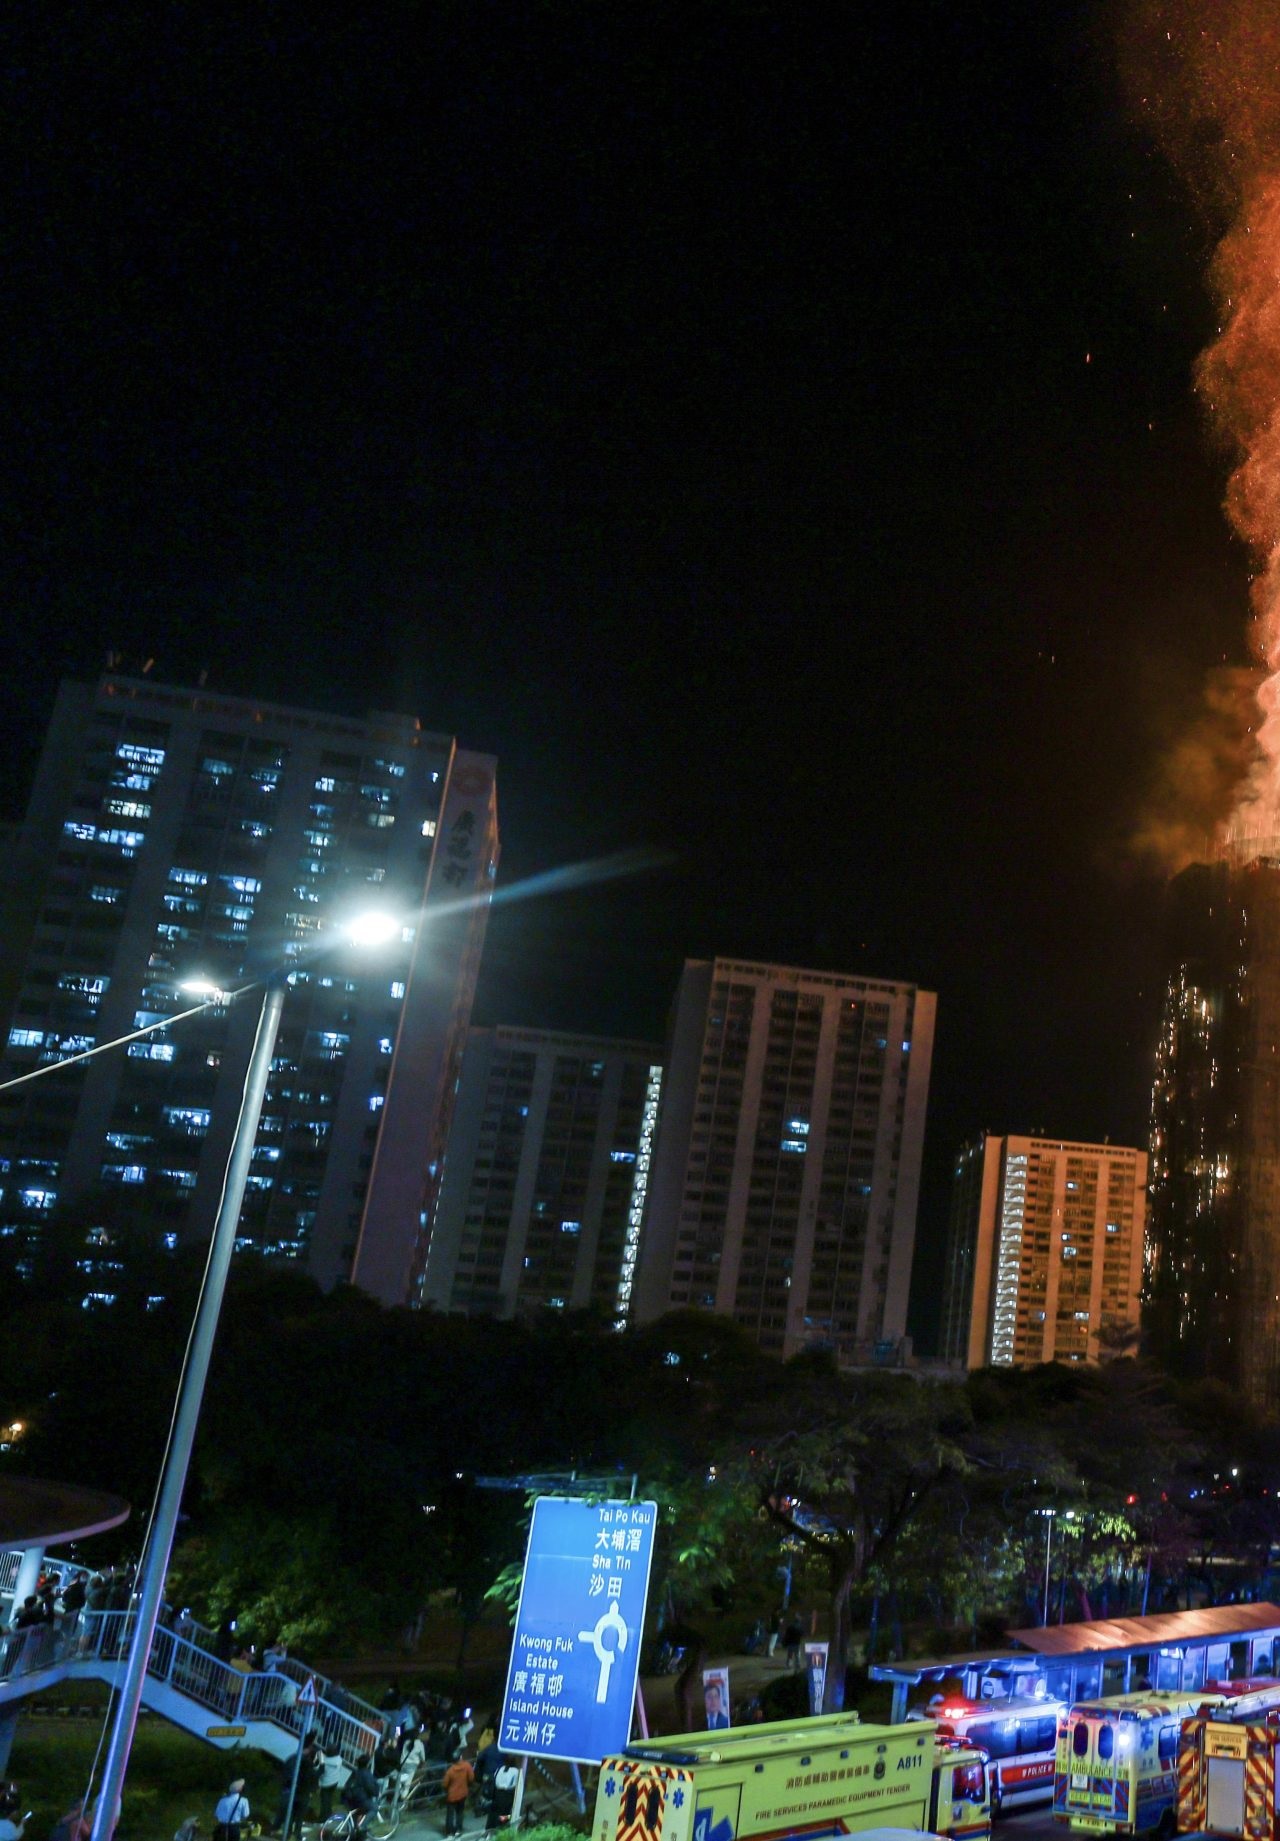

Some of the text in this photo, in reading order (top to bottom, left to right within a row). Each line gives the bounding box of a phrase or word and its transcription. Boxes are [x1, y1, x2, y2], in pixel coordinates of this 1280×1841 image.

[599, 1508, 651, 1525] Tai Po Kau
[594, 1527, 642, 1552] 大埔滘
[592, 1554, 631, 1570] Sha Tin
[588, 1573, 622, 1599] 沙田
[519, 1633, 574, 1653] Kwong Fuk
[526, 1653, 559, 1671] Estate
[512, 1670, 564, 1698] 廣福邨
[509, 1698, 574, 1719] Island House
[505, 1718, 556, 1746] 元洲仔
[896, 1754, 923, 1771] A811
[1027, 1764, 1047, 1777] POLICE
[1071, 1762, 1112, 1777] AMBULANCE
[755, 1783, 911, 1821] FIRE SERVICES PARAMEDIC EQUIPMENT TENDER
